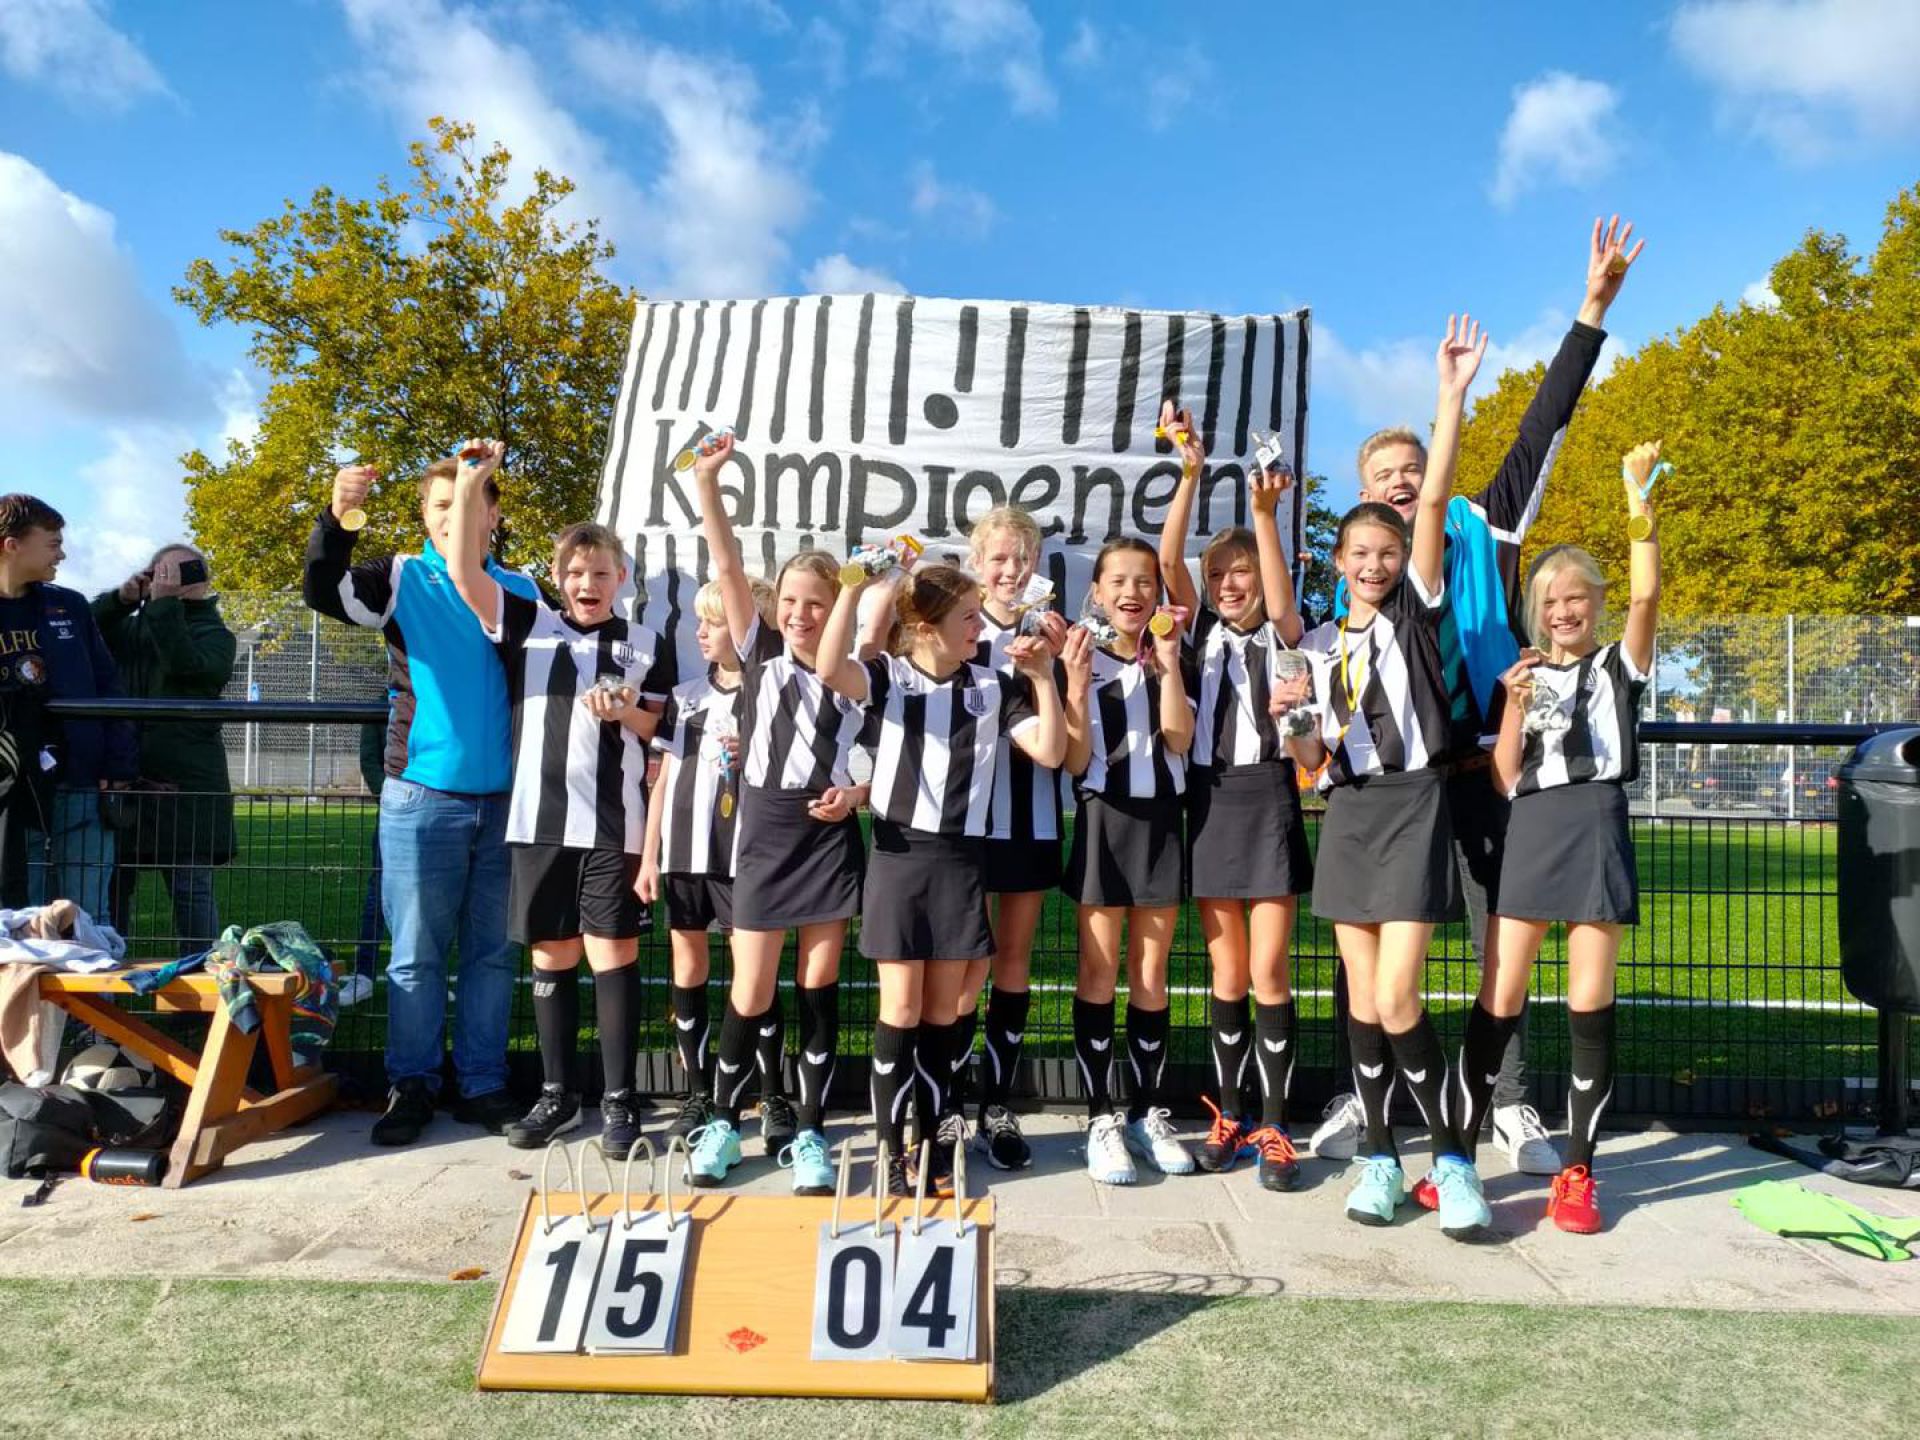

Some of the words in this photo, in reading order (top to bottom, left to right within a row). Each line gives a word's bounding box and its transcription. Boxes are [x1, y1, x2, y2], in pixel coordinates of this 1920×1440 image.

[644, 394, 1247, 557] Kampioenen
[536, 1240, 669, 1342] 15
[827, 1245, 957, 1349] 04
